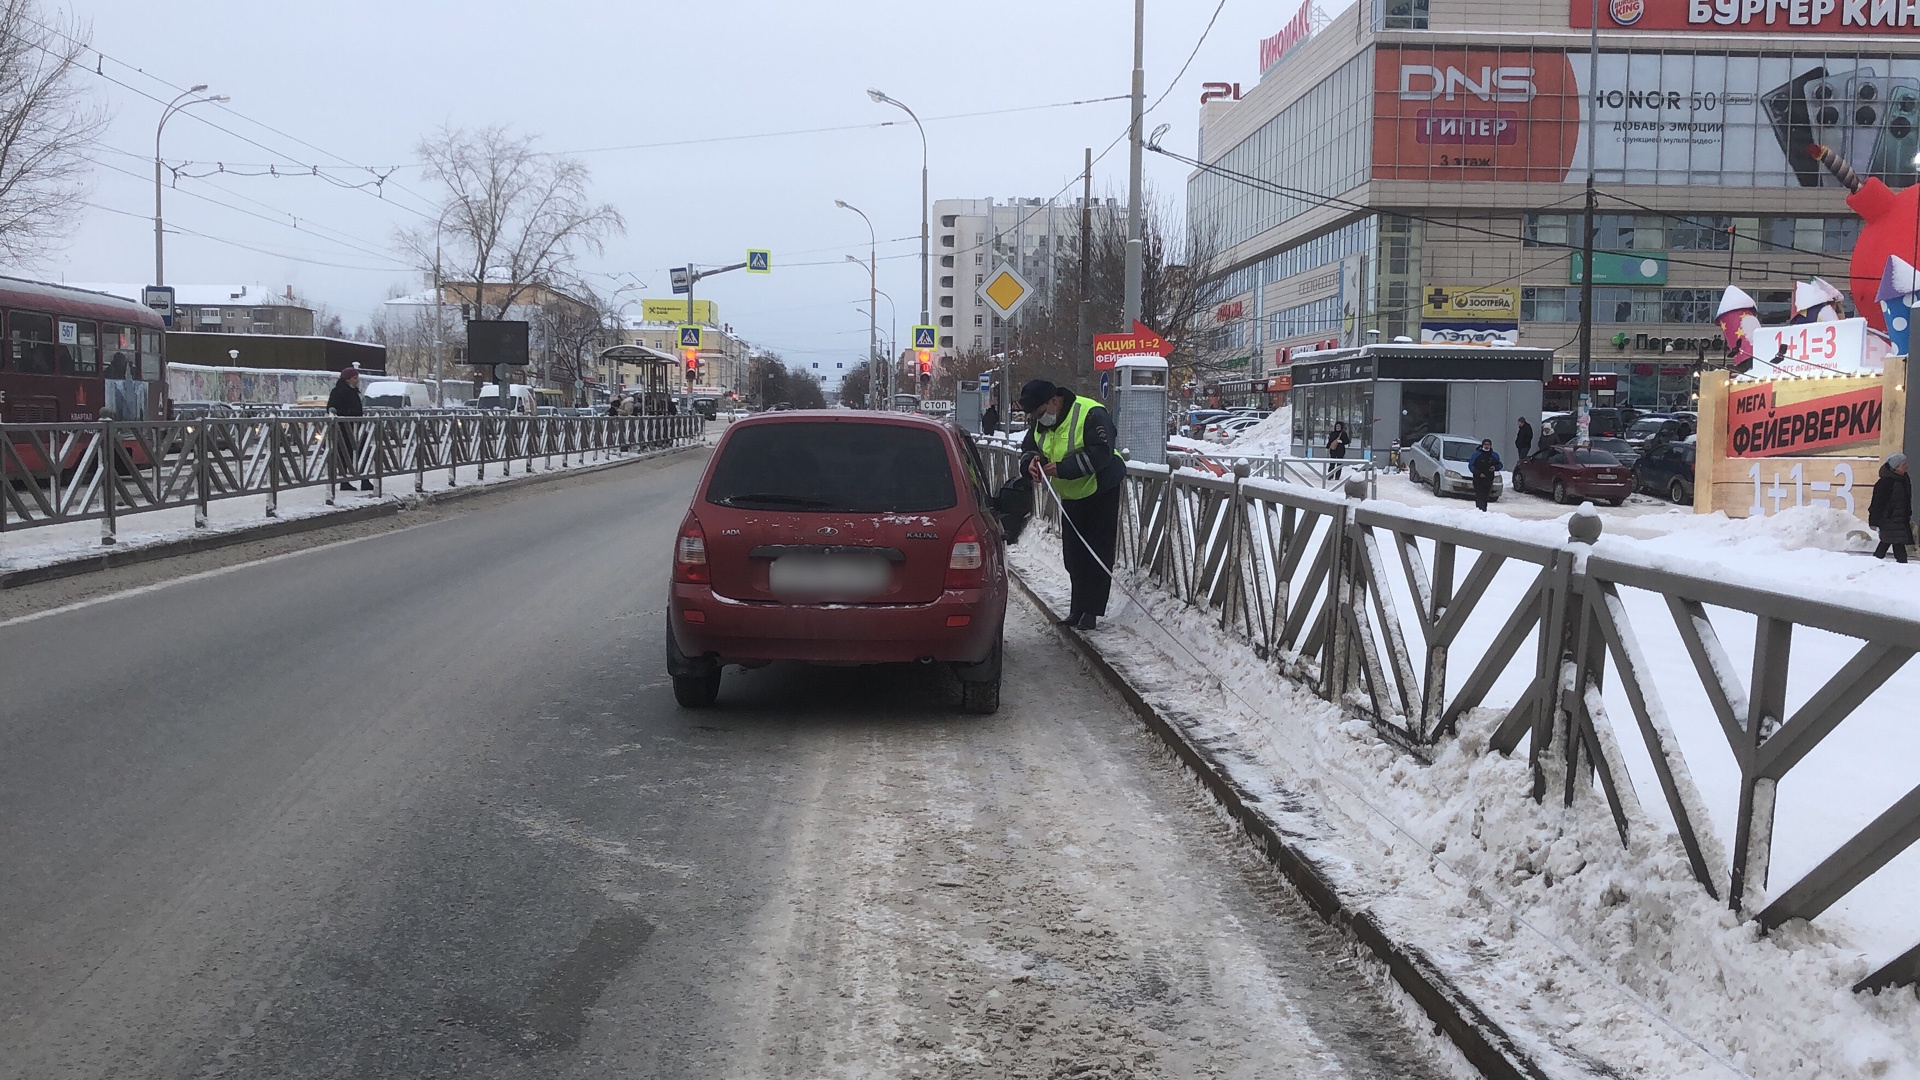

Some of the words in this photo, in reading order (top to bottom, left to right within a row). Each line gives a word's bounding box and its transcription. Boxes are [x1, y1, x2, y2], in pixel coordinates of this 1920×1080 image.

[1614, 0, 1639, 9] BURG
[1615, 2, 1640, 16] KING
[1688, 0, 1836, 25] БУРГЕР
[1260, 0, 1310, 75] КИНОМАКС
[1400, 64, 1537, 103] DNS
[1588, 89, 1681, 110] HONOR
[1689, 91, 1717, 111] 50
[1425, 116, 1508, 137] ГИПЕР
[1613, 121, 1665, 132] ДОБАВЬ
[1668, 122, 1724, 133] ЭМОЦИИ
[1440, 155, 1449, 166] 3
[1453, 157, 1491, 166] этаж
[1469, 298, 1510, 308] ЗООТРЕЙД
[61, 324, 74, 338] 567
[1096, 339, 1136, 352] АКЦИЯ
[1138, 338, 1160, 349] 1=2
[1774, 325, 1837, 361] 1+1=3
[924, 401, 947, 409] СТОП
[1736, 392, 1766, 415] МЕГА
[70, 413, 93, 421] КВАРТАЛ
[1733, 399, 1883, 456] ФЕЙЕРВЕРКИ
[1749, 462, 1855, 516] 1+1=3
[722, 528, 741, 536] LADA
[906, 531, 939, 540] KALINA
